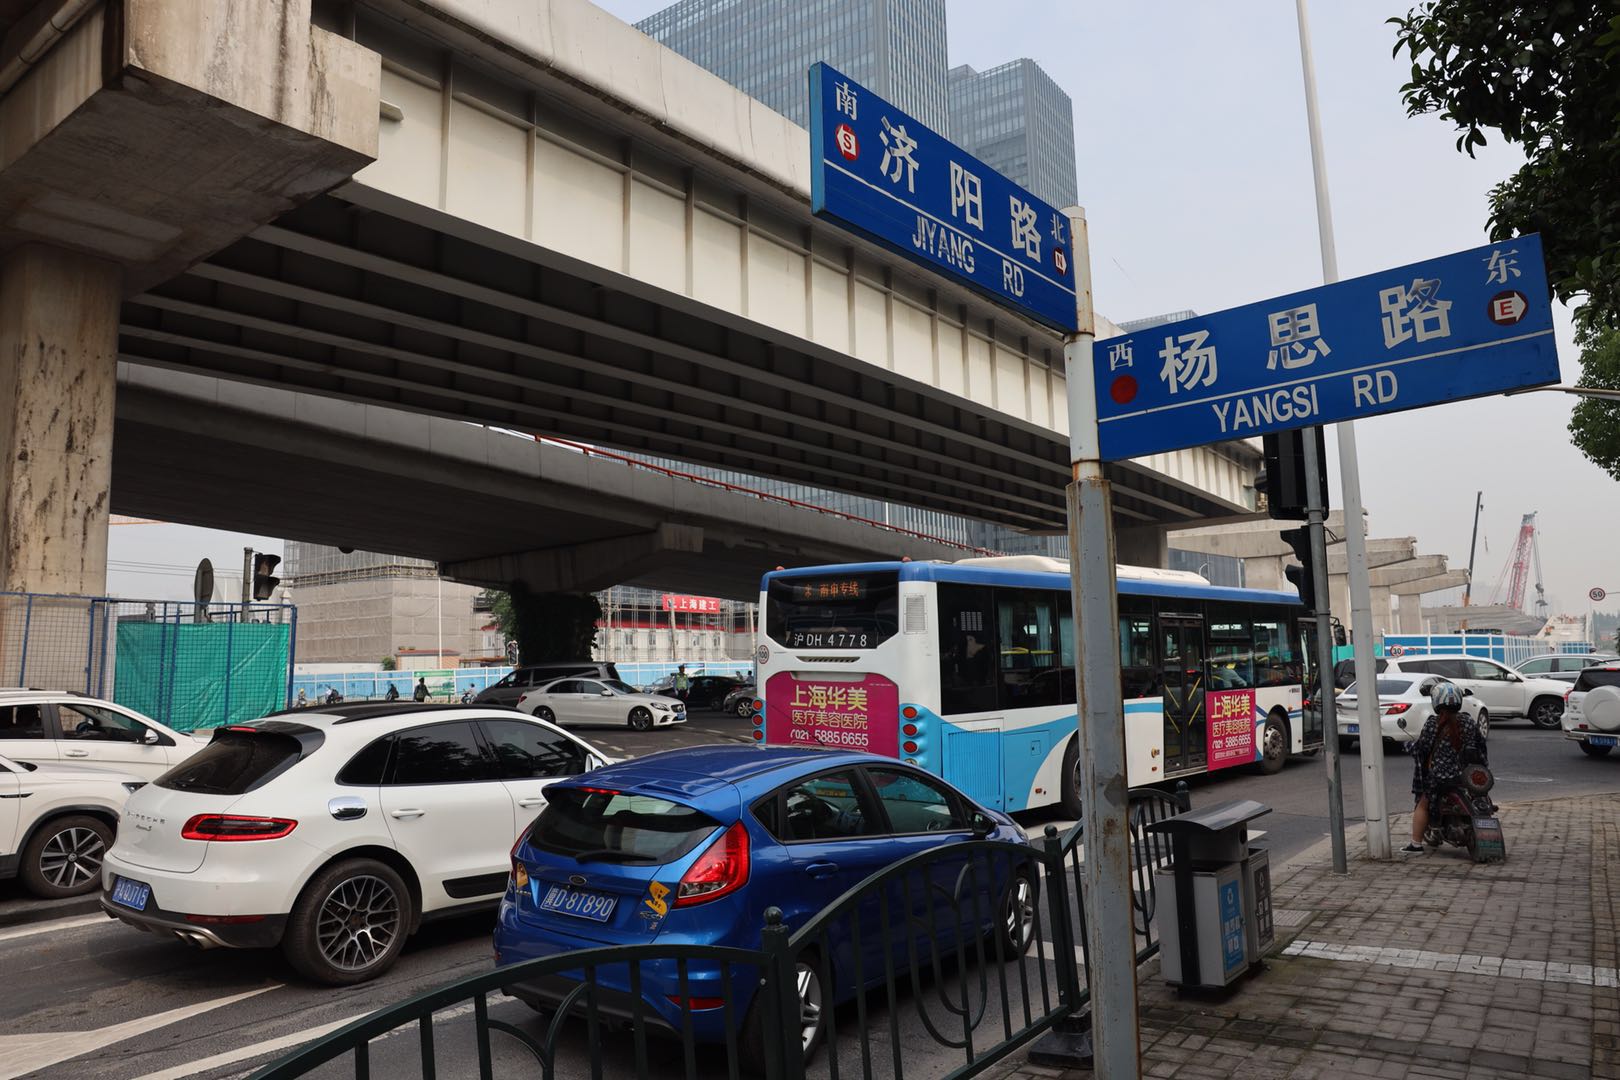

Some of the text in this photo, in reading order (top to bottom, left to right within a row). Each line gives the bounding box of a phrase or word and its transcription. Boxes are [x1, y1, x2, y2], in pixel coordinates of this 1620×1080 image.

[835, 81, 857, 121] 南
[879, 115, 1041, 264] 济阳路
[1050, 214, 1066, 245] 北
[912, 215, 1025, 298] JIYANG RD
[1482, 249, 1522, 287] 东
[1500, 300, 1514, 317] E
[1158, 277, 1453, 395] 杨思路
[1107, 339, 1134, 371] 西
[1211, 369, 1399, 433] YANGSI RD
[790, 684, 868, 712] 上海华美
[1211, 693, 1251, 719] 上海华美
[791, 708, 868, 731] 医疗美容医院
